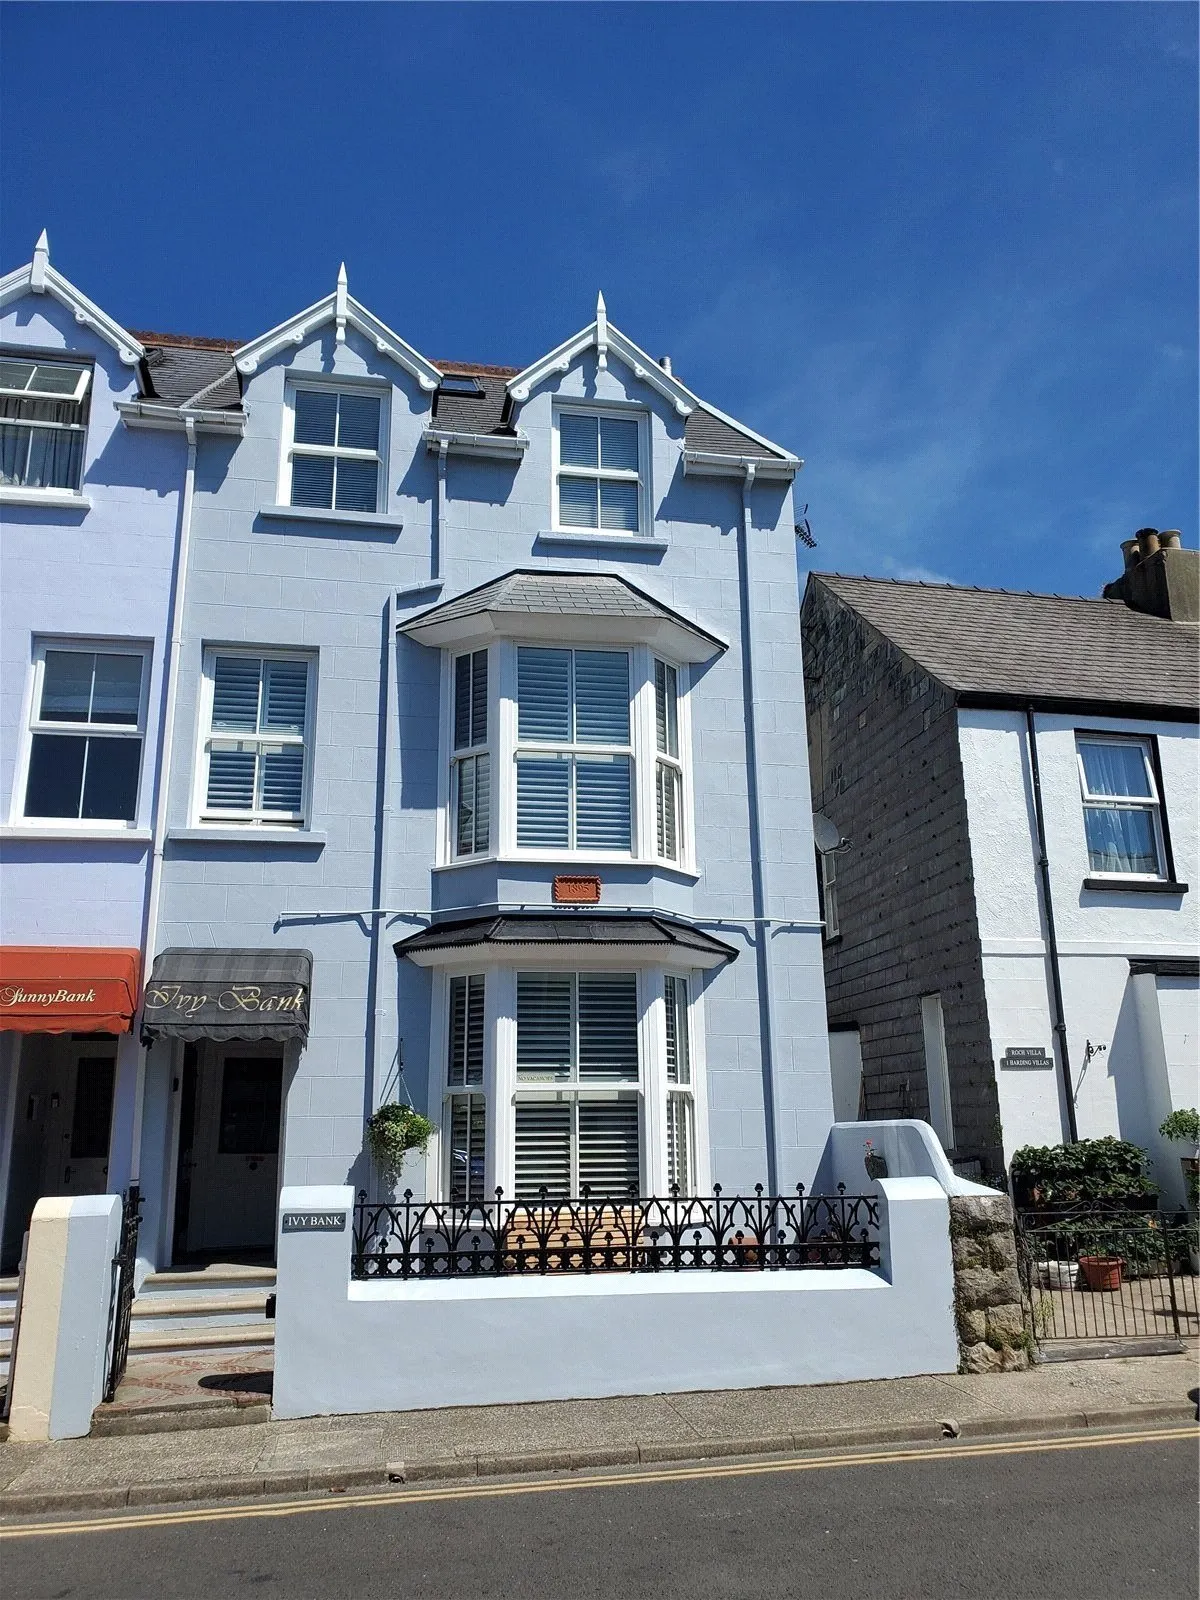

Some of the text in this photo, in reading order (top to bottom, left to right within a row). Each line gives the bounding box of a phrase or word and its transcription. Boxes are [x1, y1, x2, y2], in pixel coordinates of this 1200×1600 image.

[145, 985, 304, 1018] Ivy Bank
[288, 1216, 341, 1226] IVY BANK
